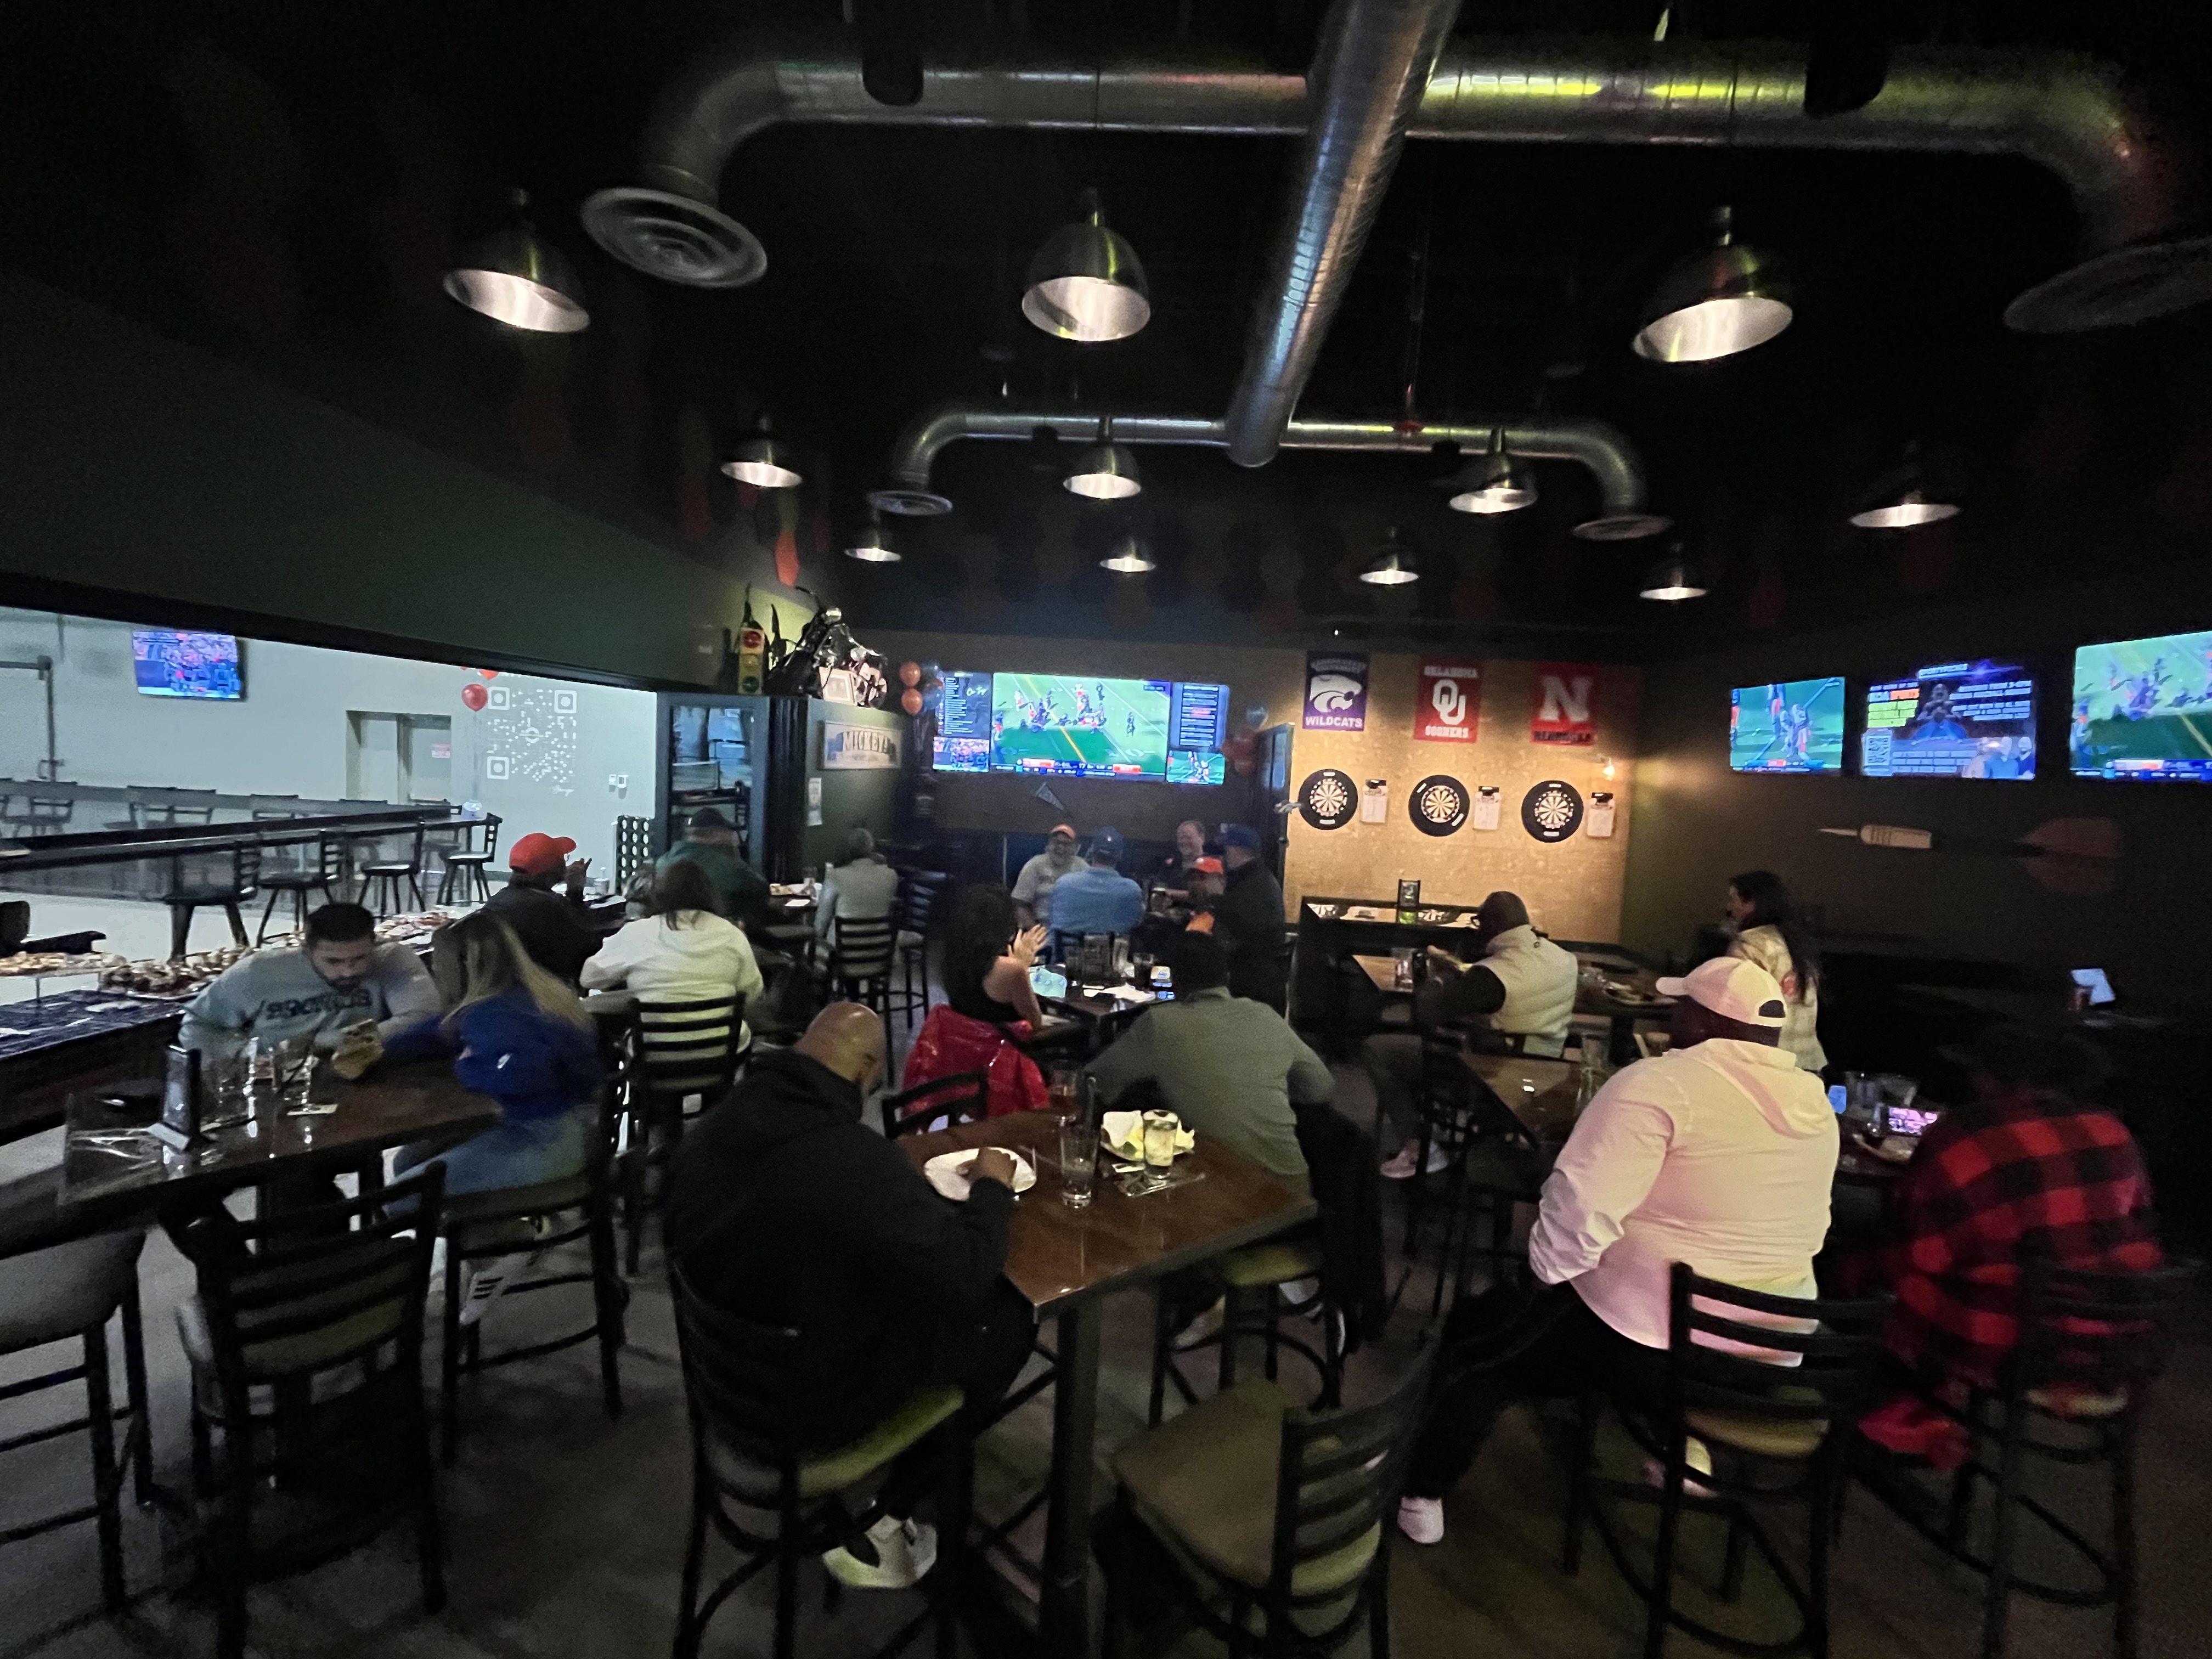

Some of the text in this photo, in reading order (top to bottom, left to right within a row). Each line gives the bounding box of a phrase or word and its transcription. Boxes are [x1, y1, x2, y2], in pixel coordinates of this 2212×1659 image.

[1432, 679, 1466, 725] OU
[1539, 675, 1595, 723] N
[1305, 715, 1363, 729] WILDCATS
[1425, 725, 1469, 739] SOONERS
[842, 730, 888, 753] MICKEY!
